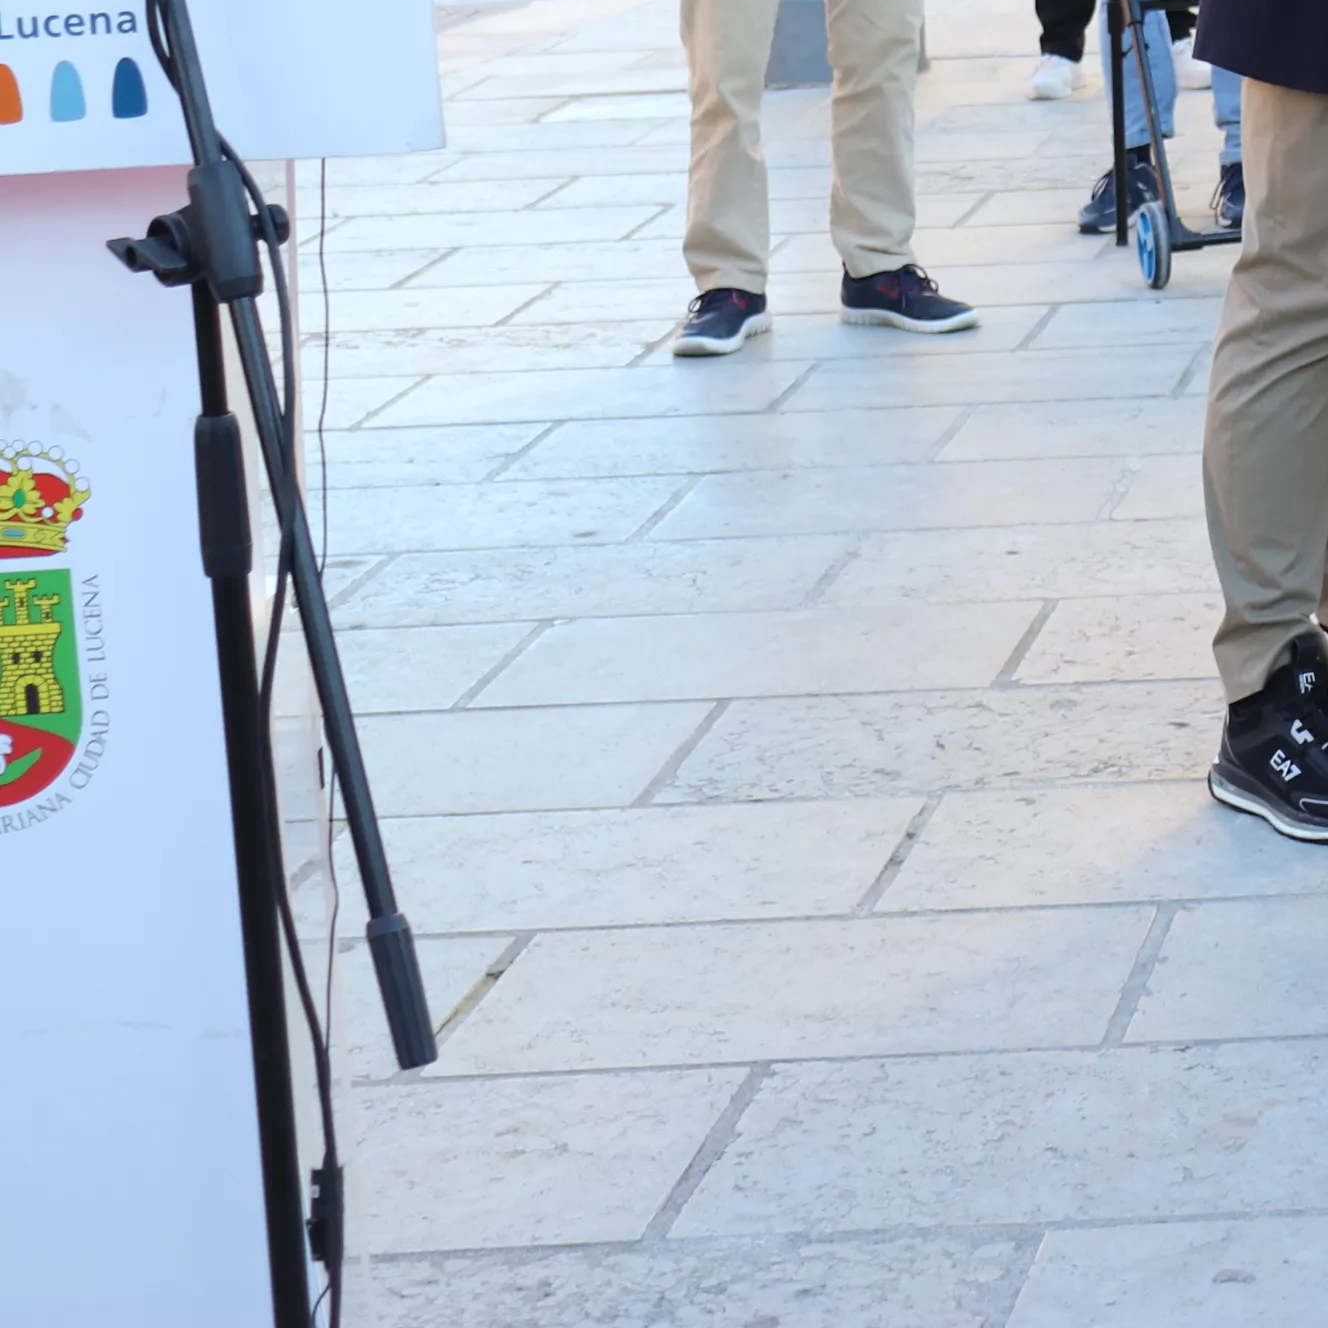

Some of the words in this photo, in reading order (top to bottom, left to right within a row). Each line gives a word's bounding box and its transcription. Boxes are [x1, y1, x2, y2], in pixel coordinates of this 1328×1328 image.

[0, 10, 137, 40] Lucena
[81, 574, 106, 663] LUCENA
[90, 672, 110, 701] DE
[69, 710, 110, 790] CIUDAD
[1269, 749, 1302, 782] EA7
[0, 792, 73, 834] RIANA
